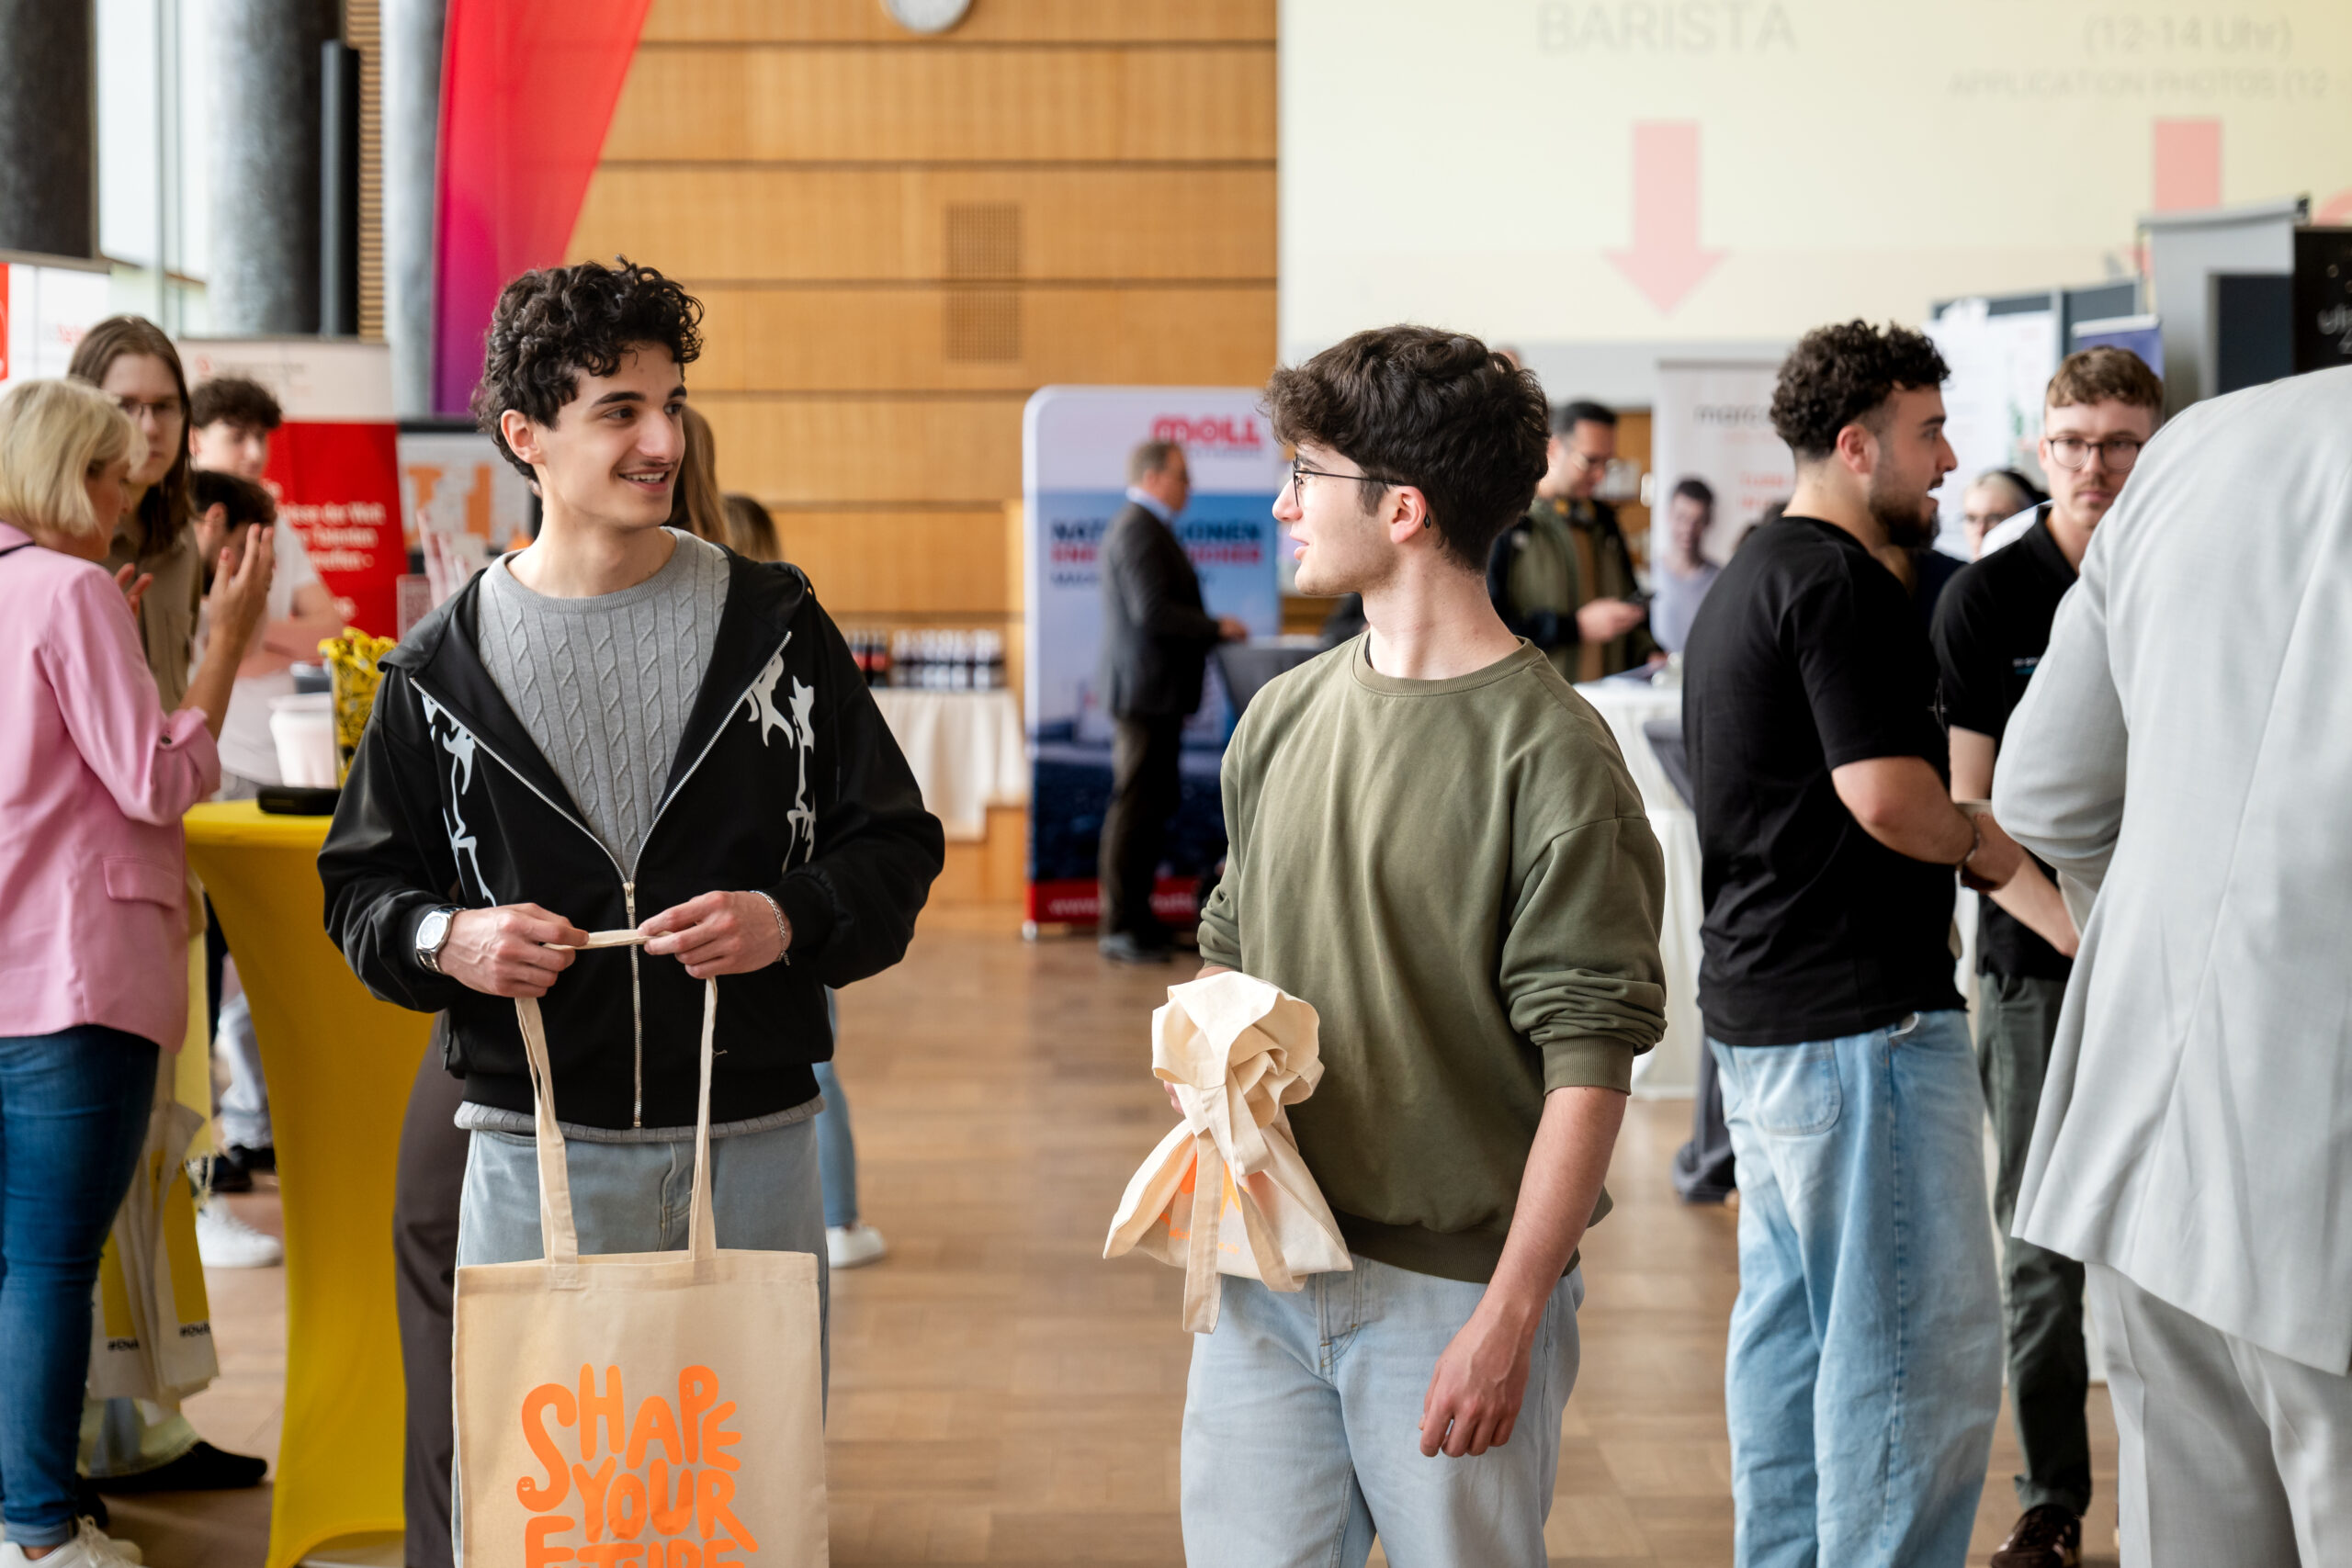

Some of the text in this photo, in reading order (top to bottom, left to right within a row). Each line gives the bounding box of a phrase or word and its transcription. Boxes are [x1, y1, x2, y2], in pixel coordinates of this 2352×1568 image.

[1536, 0, 1799, 55] BARISTA
[2082, 12, 2294, 61] (12-14 Uhr)
[1947, 67, 2146, 99] APPLICATION
[2153, 67, 2276, 99] PHOTOS
[516, 1363, 742, 1512] SHAPE
[571, 1456, 759, 1552] YOUR
